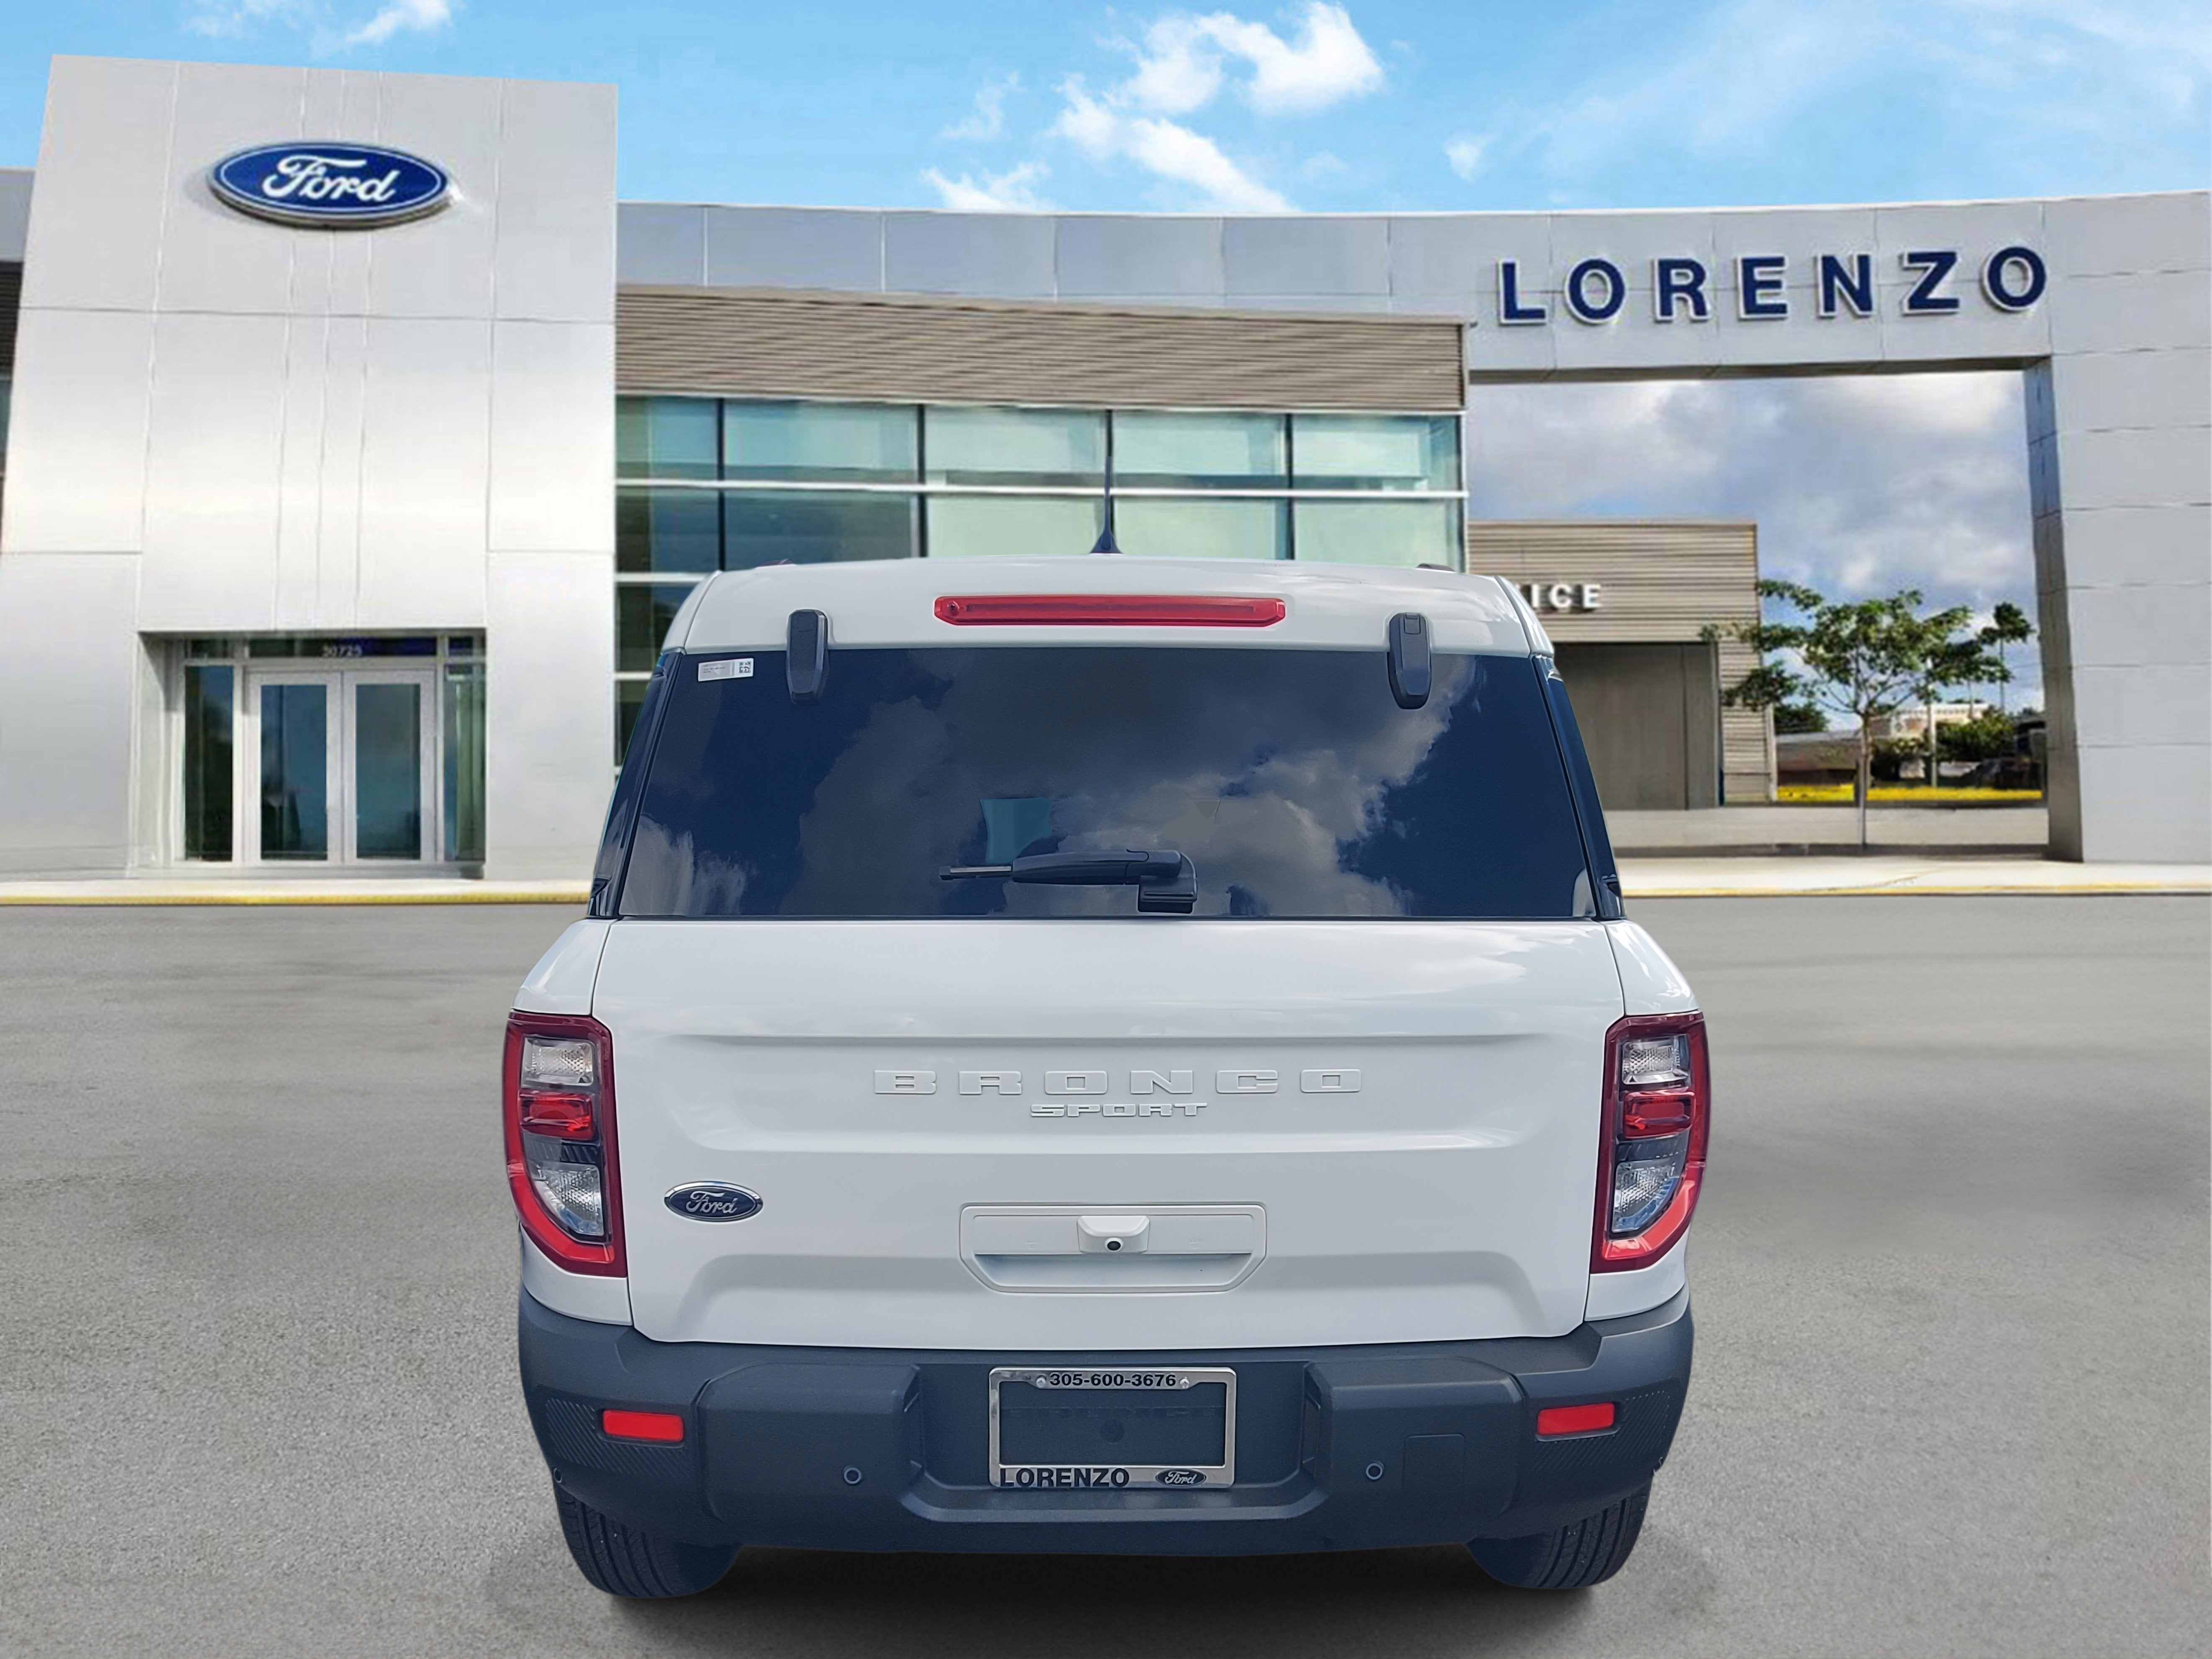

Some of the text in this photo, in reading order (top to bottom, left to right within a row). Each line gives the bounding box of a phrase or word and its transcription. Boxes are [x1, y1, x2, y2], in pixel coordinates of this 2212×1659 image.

[262, 155, 400, 202] Ford
[1498, 246, 2047, 325] LORENZO
[1517, 583, 1603, 608] ICE
[874, 1069, 1362, 1095] BRONCO
[1030, 1102, 1208, 1117] SPORT
[685, 1190, 738, 1213] Ford
[1049, 1373, 1177, 1387] 305-600-3676
[1000, 1467, 1197, 1487] LORENZO Ford
